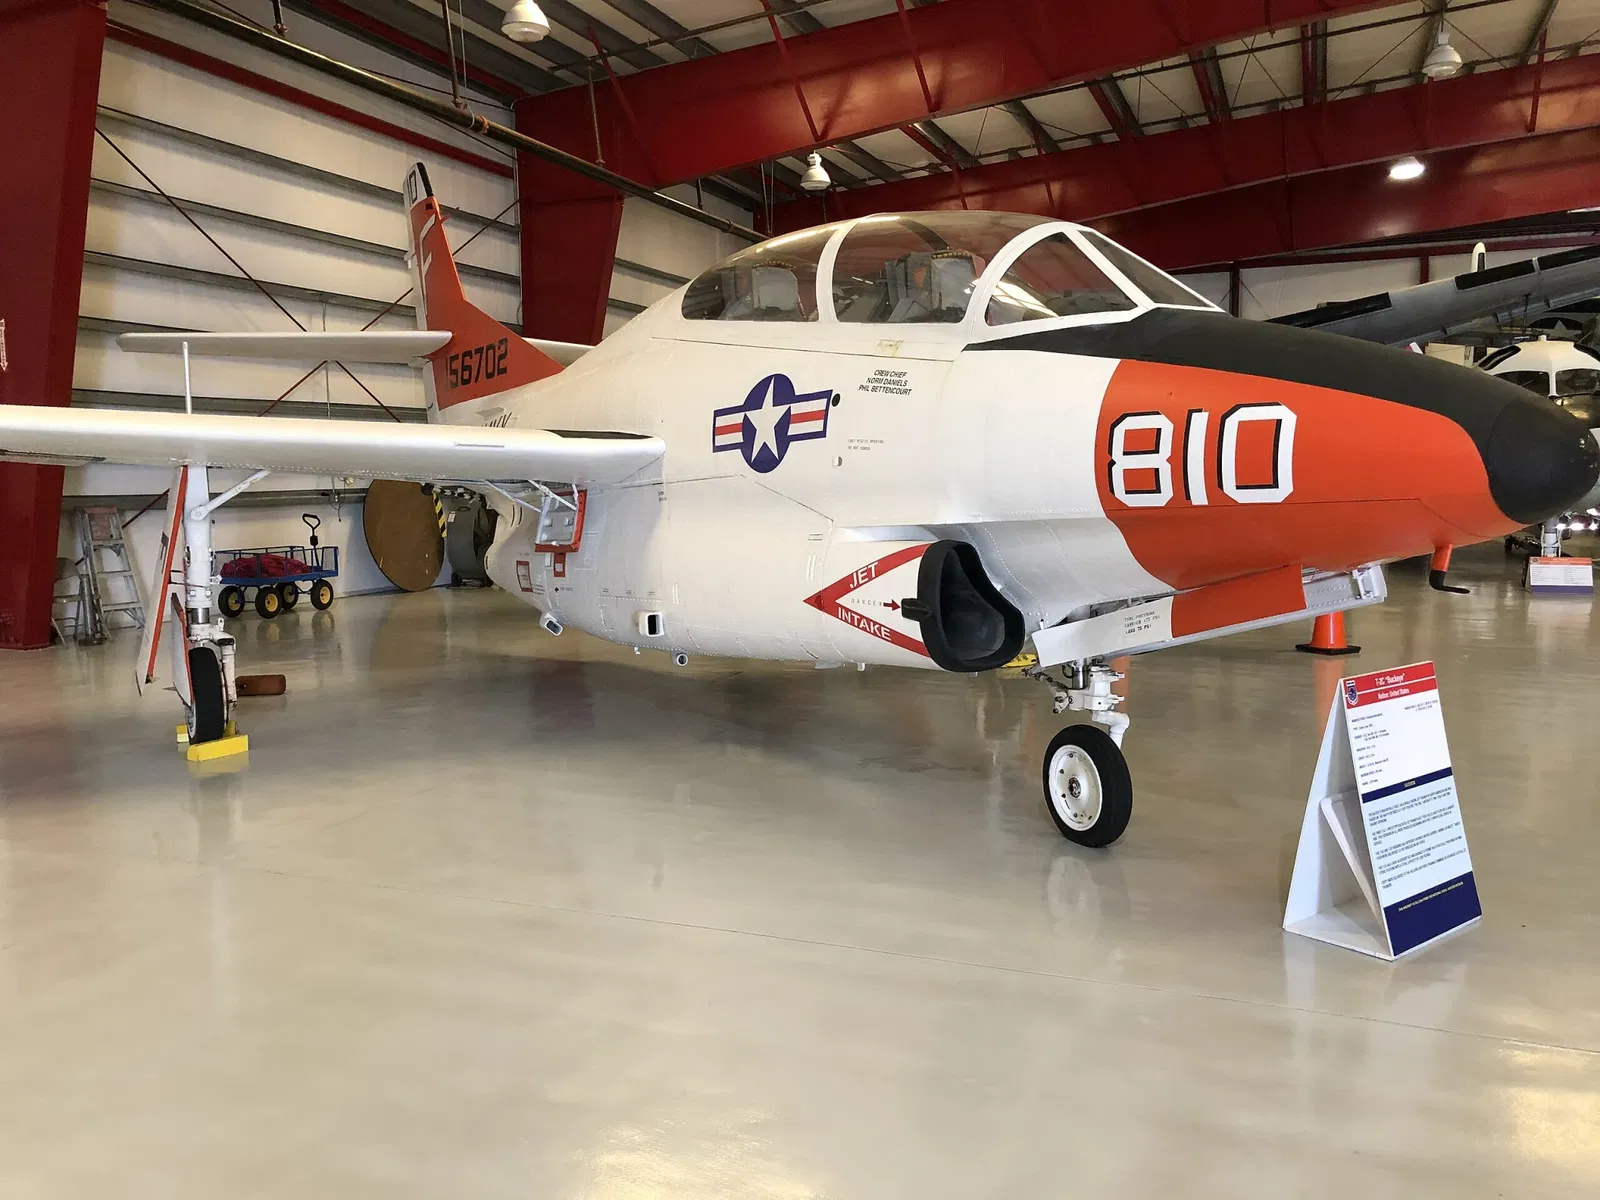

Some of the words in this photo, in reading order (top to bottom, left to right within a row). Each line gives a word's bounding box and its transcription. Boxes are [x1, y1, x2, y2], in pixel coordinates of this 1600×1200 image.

[445, 337, 508, 394] 156702
[873, 369, 890, 377] CREW
[858, 384, 870, 392] PHIL
[871, 385, 912, 395] BETTENCOURT
[866, 377, 883, 385] NORM
[883, 378, 908, 386] DANIELS
[1107, 401, 1298, 507] 810
[849, 562, 879, 589] JET
[838, 607, 892, 641] INTAKE
